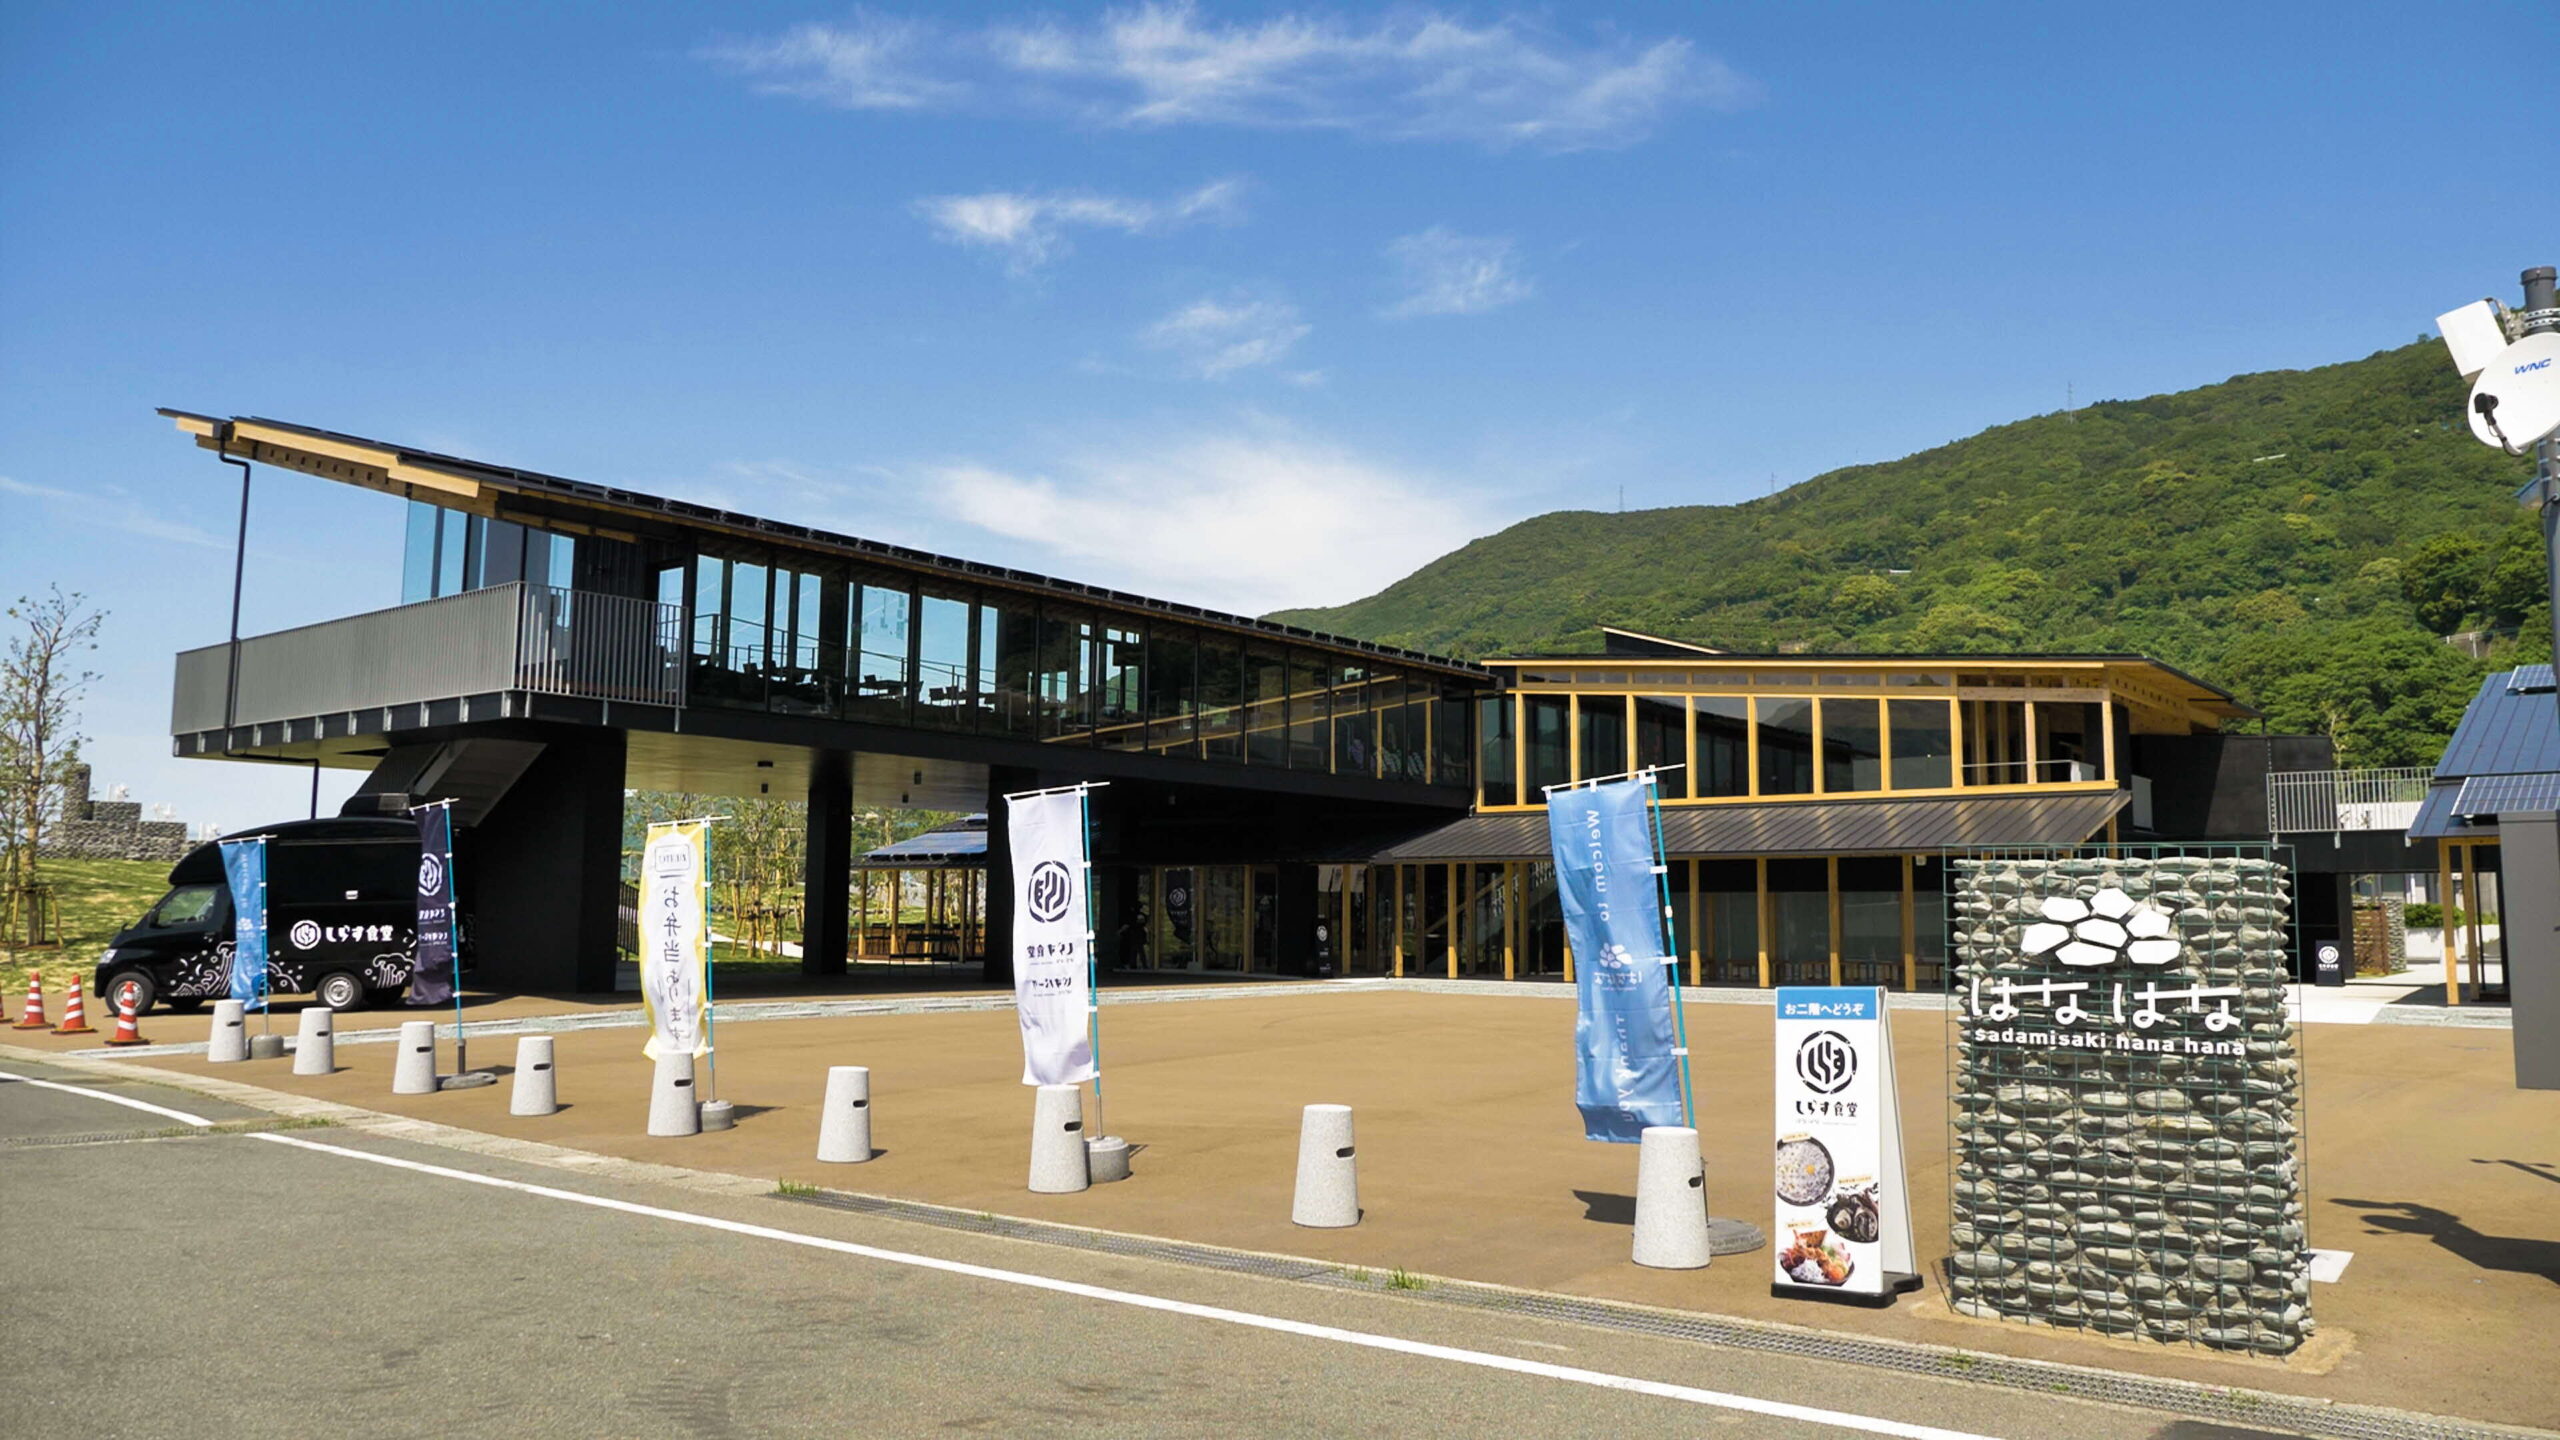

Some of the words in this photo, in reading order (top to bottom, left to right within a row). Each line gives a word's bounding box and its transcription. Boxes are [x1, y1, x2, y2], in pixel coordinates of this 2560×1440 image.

[2514, 358, 2551, 375] WNC
[325, 924, 394, 942] しらす食堂
[1784, 1003, 1865, 1017] お二階へどうぞ
[1971, 977, 2242, 1032] はなはな
[1974, 1027, 2107, 1048] sadamisaki
[2116, 1034, 2175, 1052] hana
[2184, 1037, 2247, 1056] hana
[1795, 1100, 1858, 1117] しらす食堂
